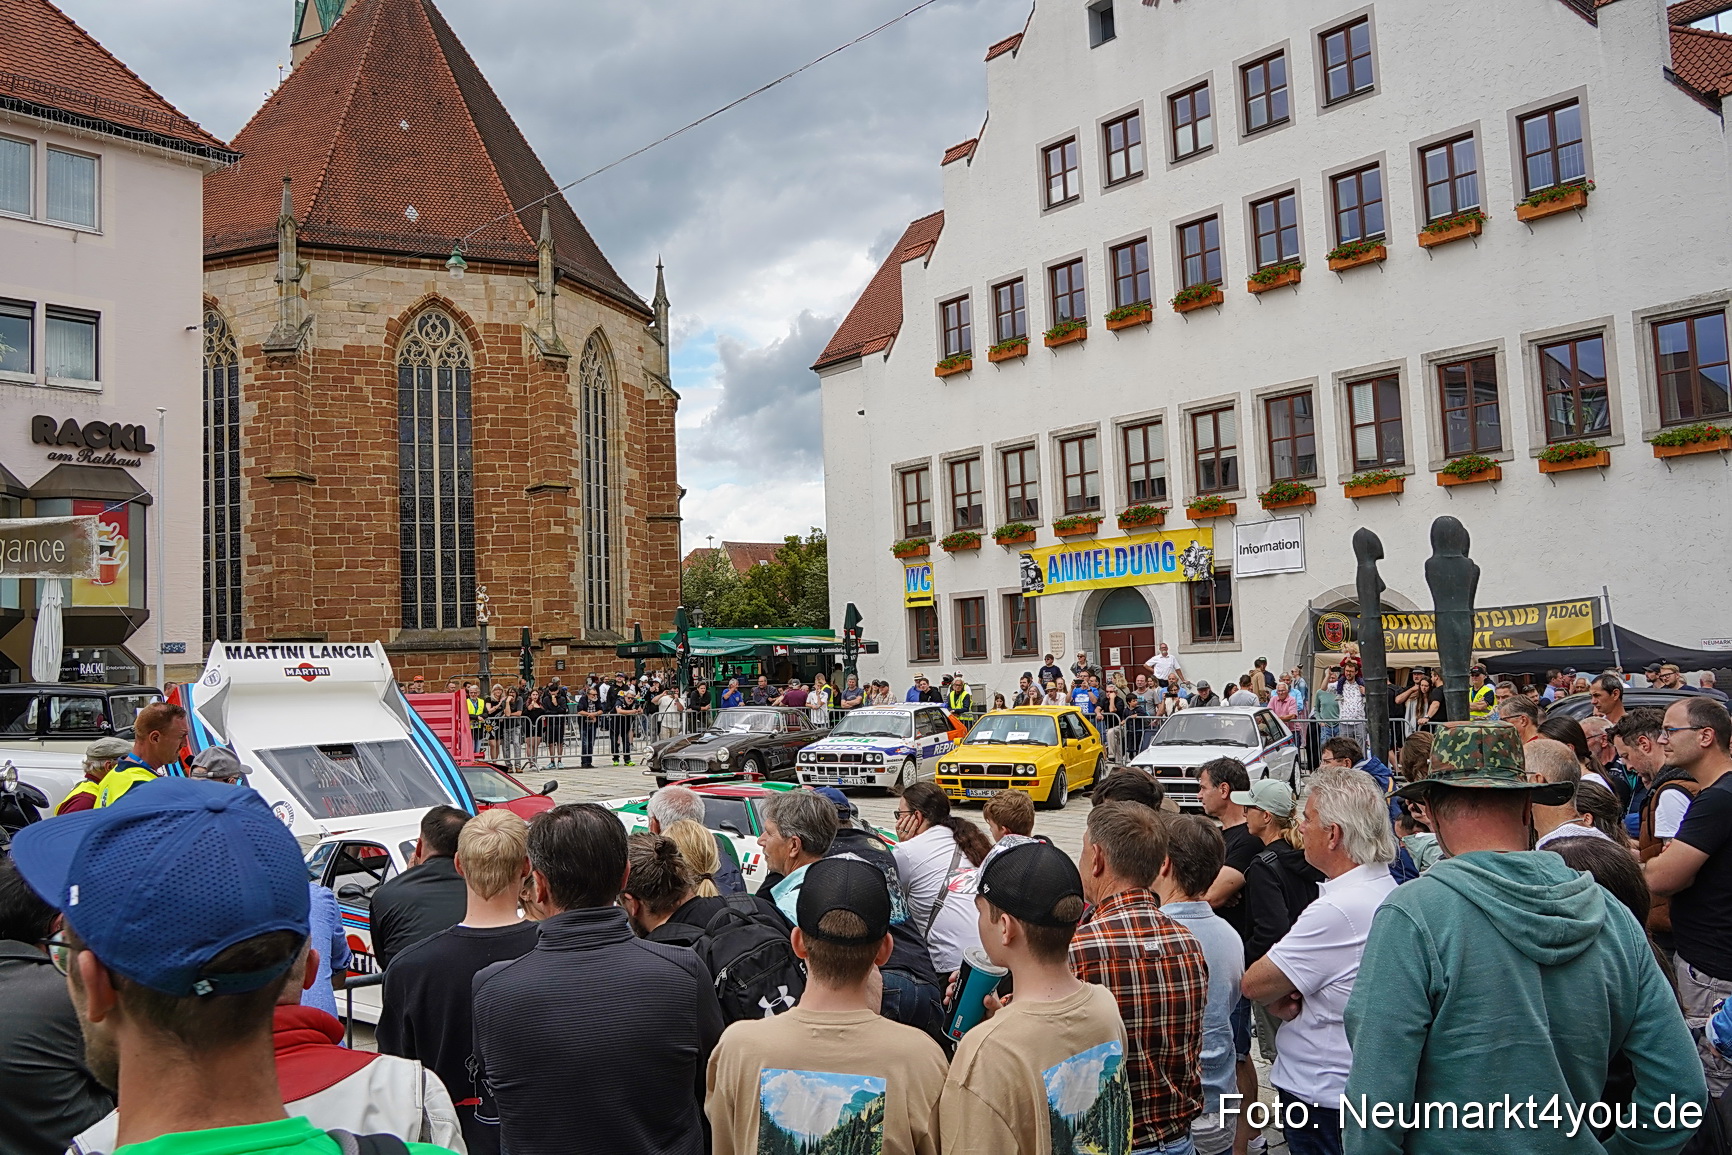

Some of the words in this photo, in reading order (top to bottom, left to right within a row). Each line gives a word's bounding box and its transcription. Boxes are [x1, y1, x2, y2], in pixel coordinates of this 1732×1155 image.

[32, 415, 155, 453] RACKL
[47, 452, 74, 462] am
[76, 448, 142, 467] Rathaus
[1239, 536, 1300, 556] Information
[1047, 539, 1177, 585] ANMELDUNG
[905, 565, 932, 593] WC
[1548, 603, 1590, 620] ADAC
[1495, 638, 1514, 648] e.V.
[225, 645, 305, 660] MARTINI
[309, 645, 374, 659] LANCIA
[80, 662, 105, 674] RACKL
[285, 667, 330, 676] MARTINI
[741, 863, 758, 875] HF
